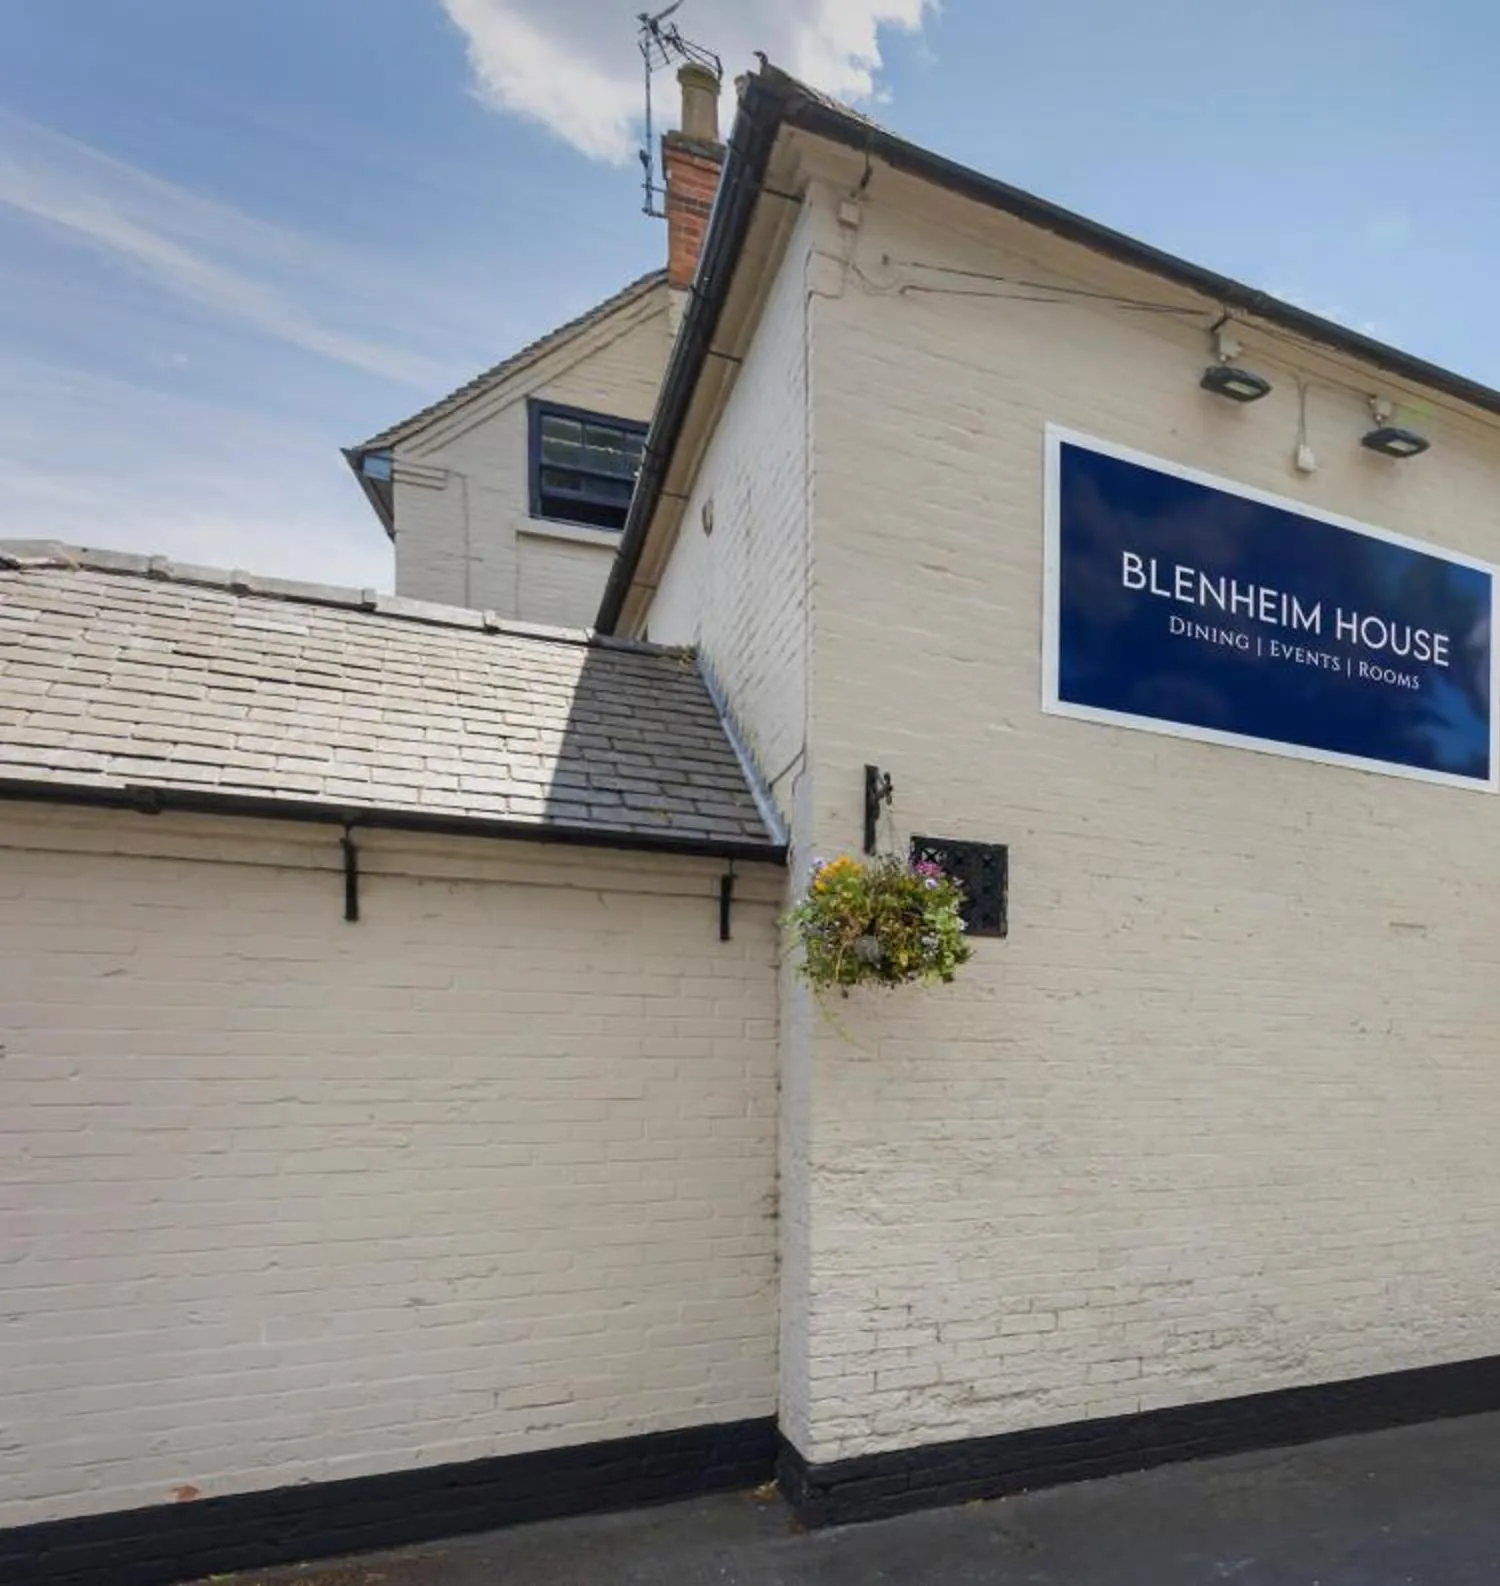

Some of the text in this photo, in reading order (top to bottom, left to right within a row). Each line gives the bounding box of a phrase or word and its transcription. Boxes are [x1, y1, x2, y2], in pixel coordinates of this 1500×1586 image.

[1122, 551, 1451, 667] BLENHEIM HOUSE
[1169, 615, 1250, 650] DINING
[1270, 639, 1341, 672] EVENTS
[1359, 661, 1420, 690] ROOMS
